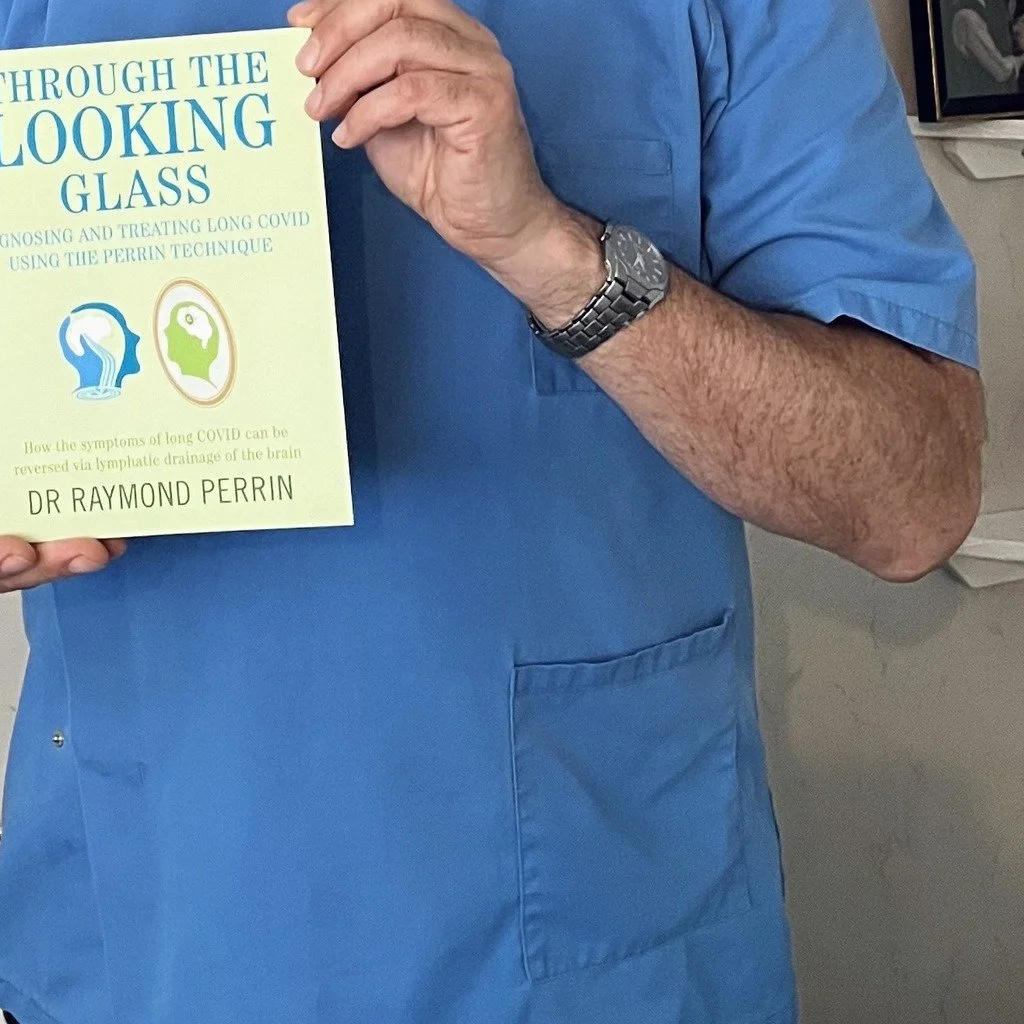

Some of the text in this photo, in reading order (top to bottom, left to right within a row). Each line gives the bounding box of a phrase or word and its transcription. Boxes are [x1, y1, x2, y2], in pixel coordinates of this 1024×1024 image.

[189, 50, 269, 89] THE
[60, 164, 212, 214] GLASS
[79, 226, 114, 244] AND
[117, 218, 201, 239] TREATING
[207, 214, 252, 233] LONG
[258, 211, 310, 229] COVID
[9, 237, 273, 272] USING THE PERRIN TECHNIQUE
[24, 425, 288, 454] How the symptoms of long COVID can be
[14, 445, 301, 476] reversed via lymphatic drainage of the brain
[28, 474, 294, 515] DR RAYMOND PERRIN
